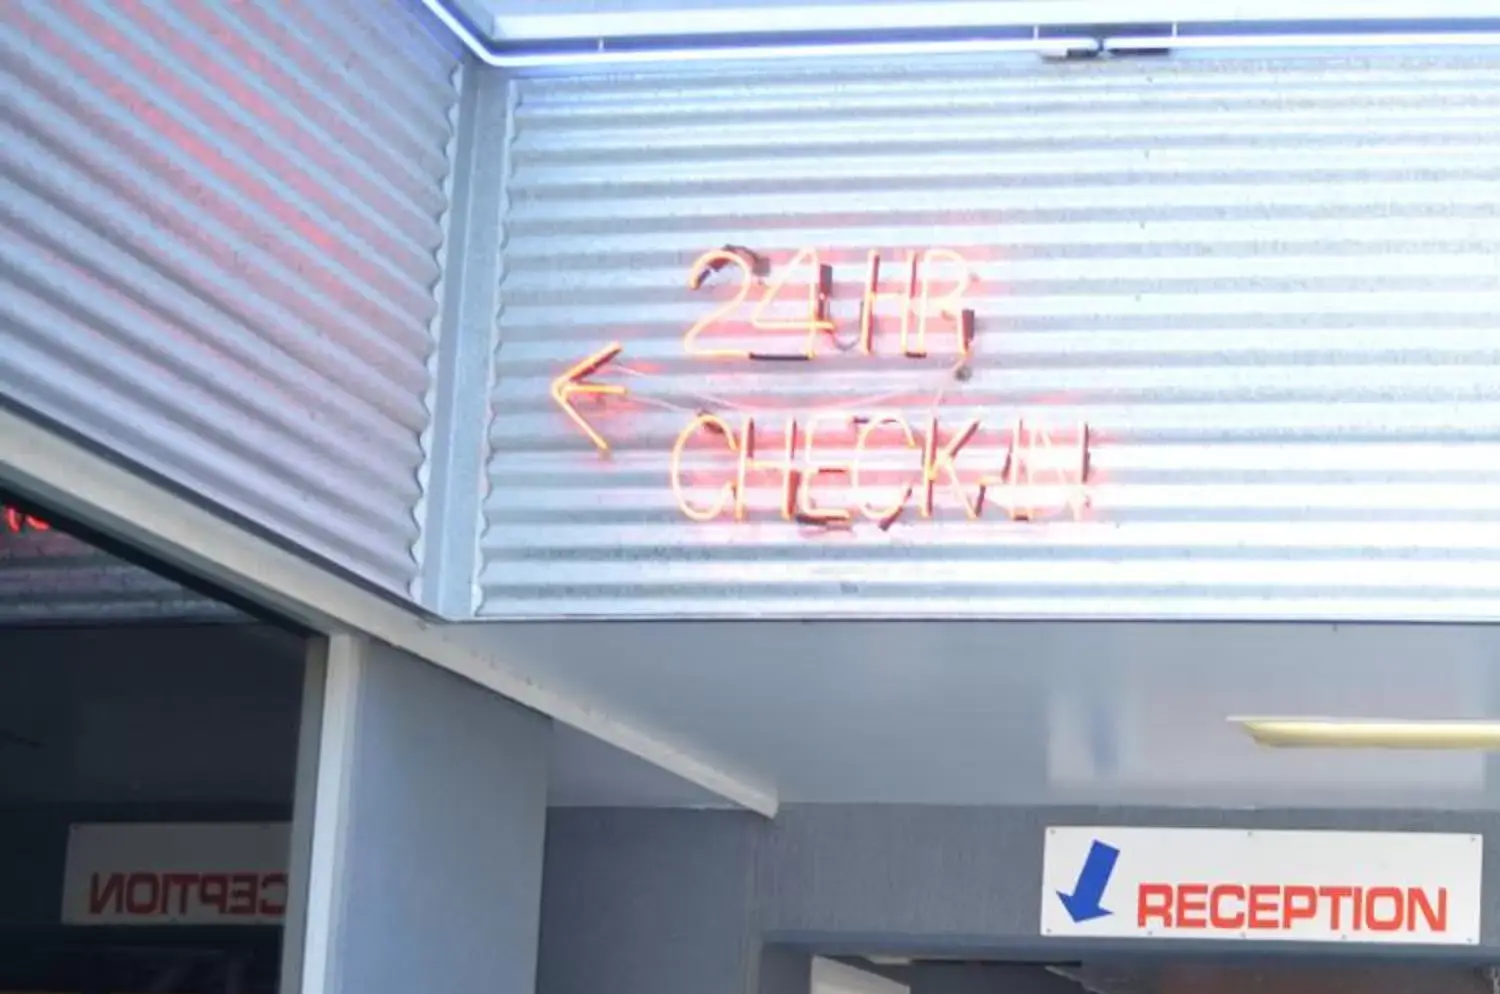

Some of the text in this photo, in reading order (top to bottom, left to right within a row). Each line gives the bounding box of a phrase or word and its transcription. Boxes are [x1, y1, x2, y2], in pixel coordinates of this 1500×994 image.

[684, 247, 972, 359] 24 HR
[1137, 882, 1448, 932] RECEPTION
